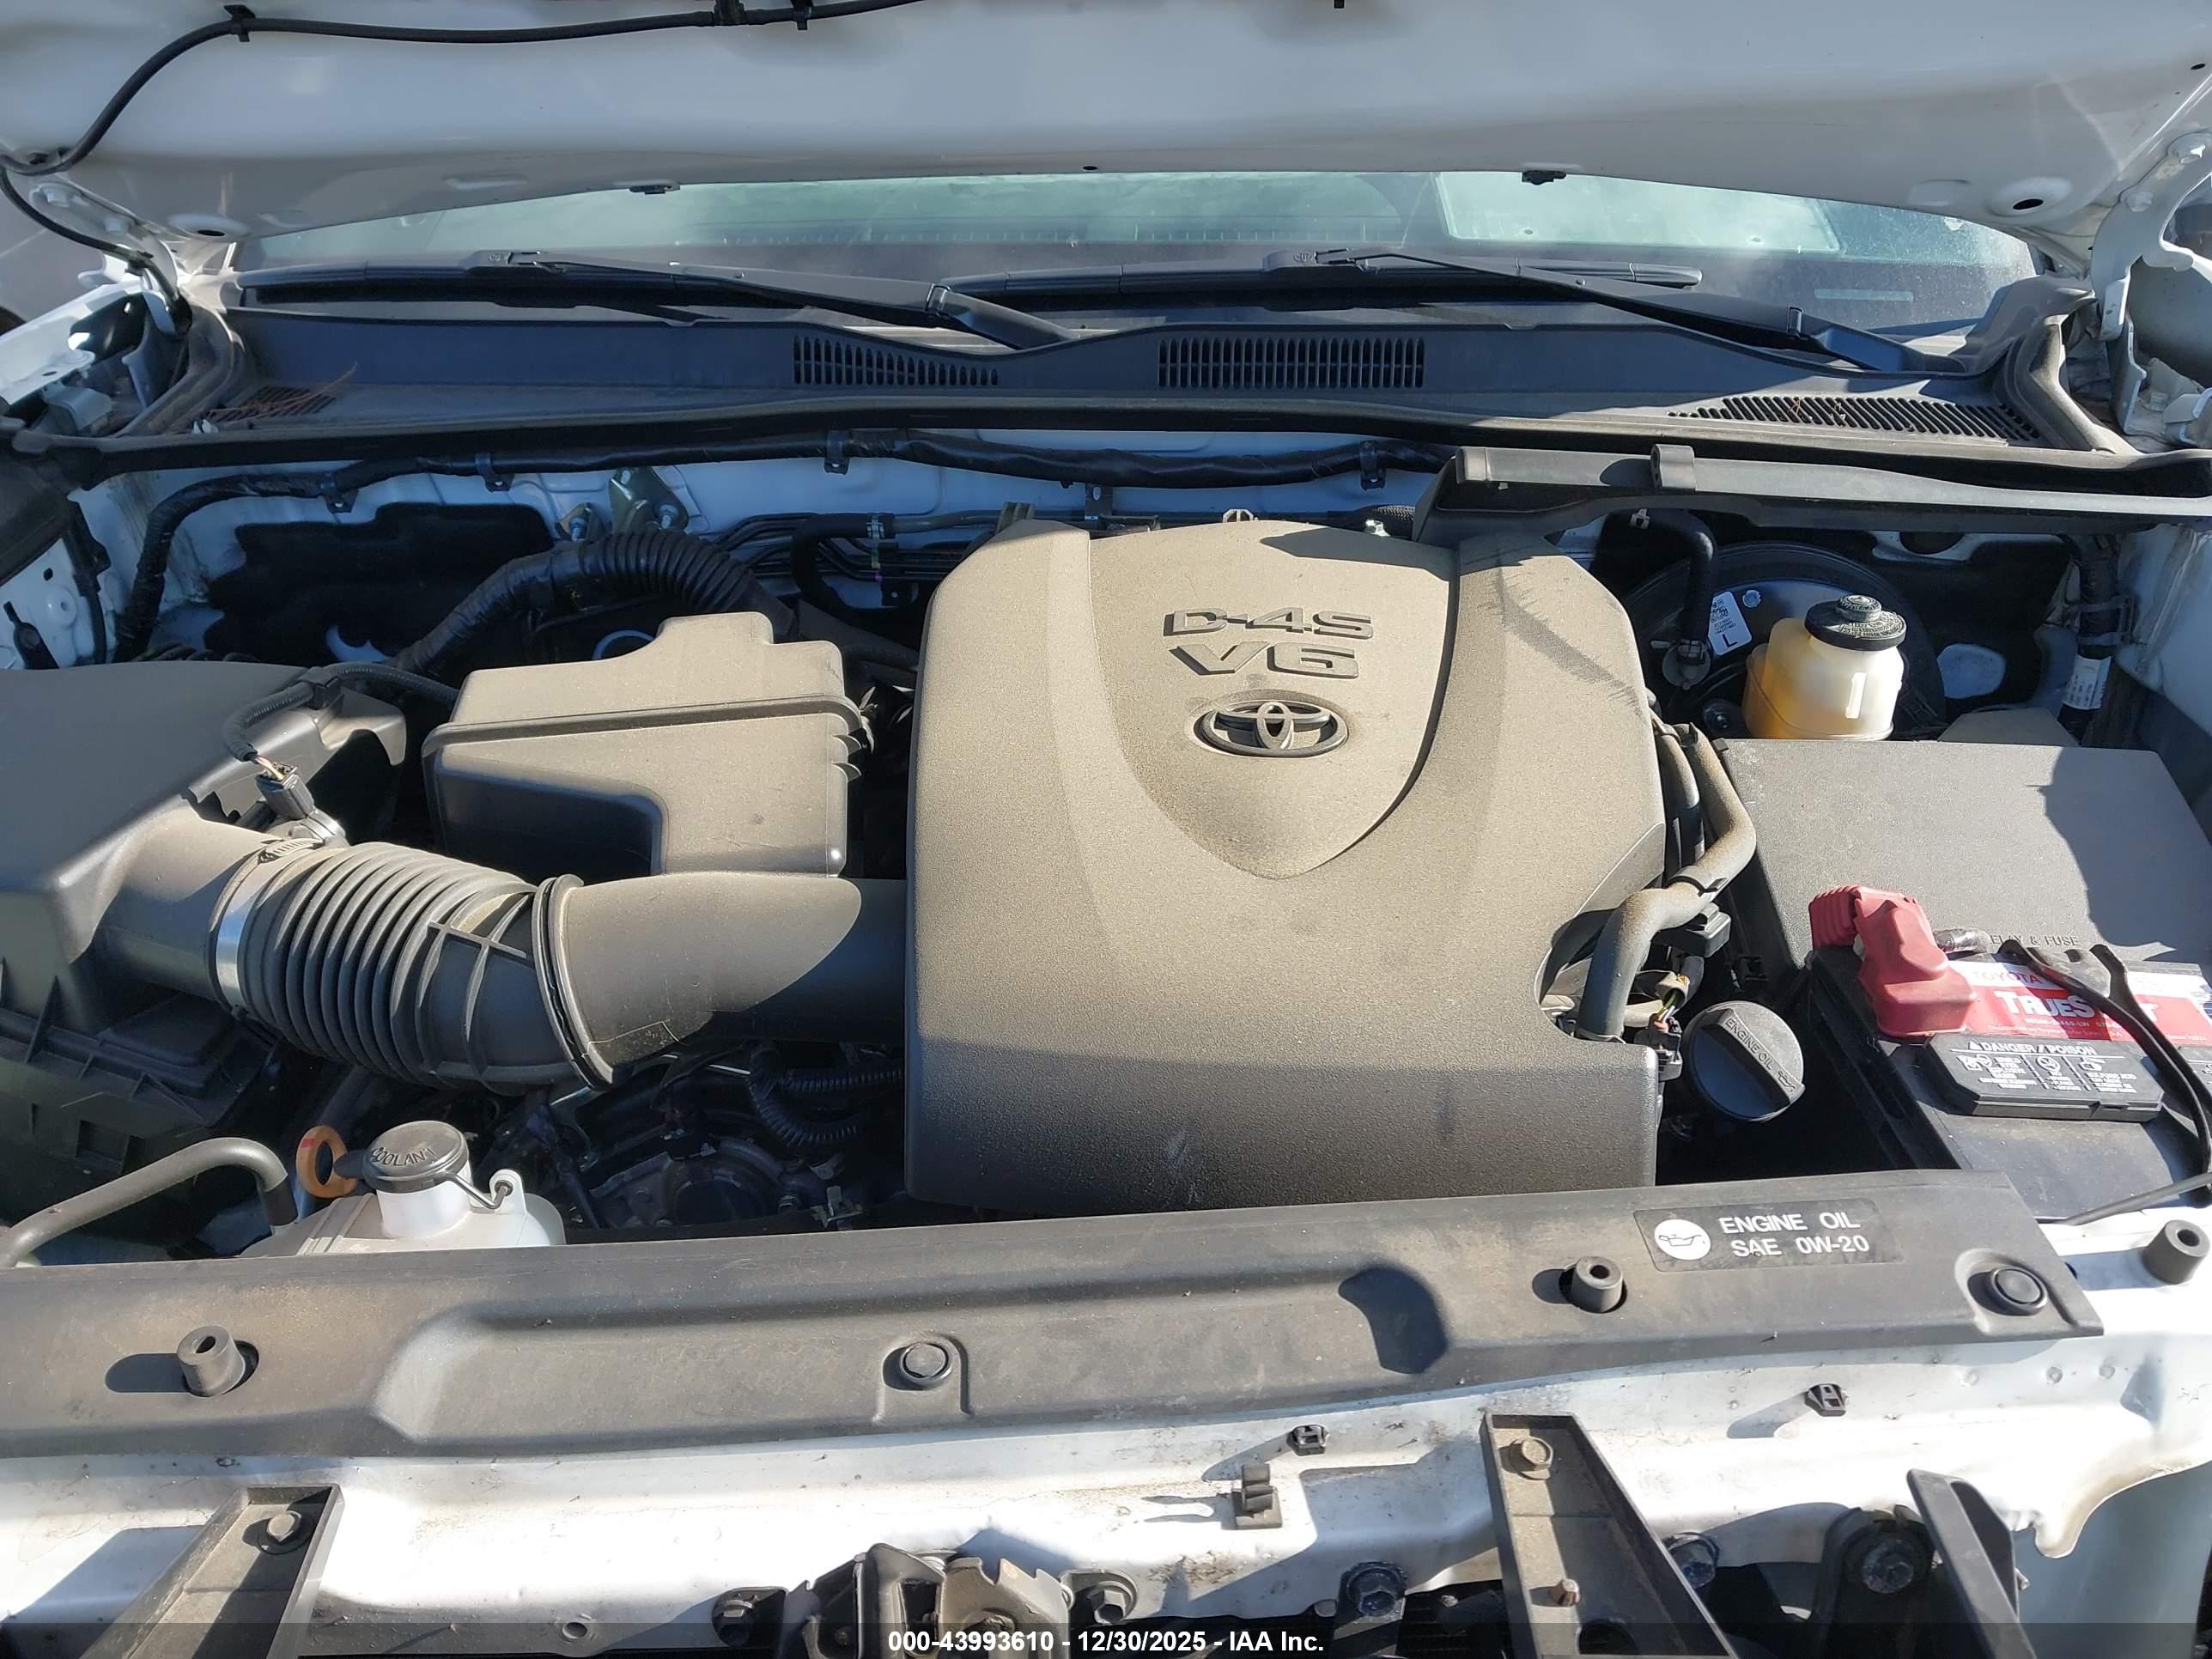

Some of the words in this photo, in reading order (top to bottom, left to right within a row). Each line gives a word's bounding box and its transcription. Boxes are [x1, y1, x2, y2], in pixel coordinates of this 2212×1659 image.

[1163, 607, 1374, 639] D-4S
[1722, 634, 1738, 647] L
[1169, 641, 1358, 679] V6
[2029, 935, 2041, 945] &
[2045, 935, 2081, 946] FUSE
[1972, 970, 2043, 985] TOYOTA
[1725, 1018, 1759, 1054] ENGINE
[1758, 1052, 1774, 1071] OIL
[1979, 1042, 2036, 1053] DANGER
[2045, 1044, 2098, 1055] POISON
[372, 1146, 436, 1166] COOLANT
[1718, 1213, 1808, 1235] ENGINE
[1820, 1211, 1861, 1230] OIL
[1731, 1237, 1783, 1258] SAE
[1796, 1234, 1870, 1255] 0W-20
